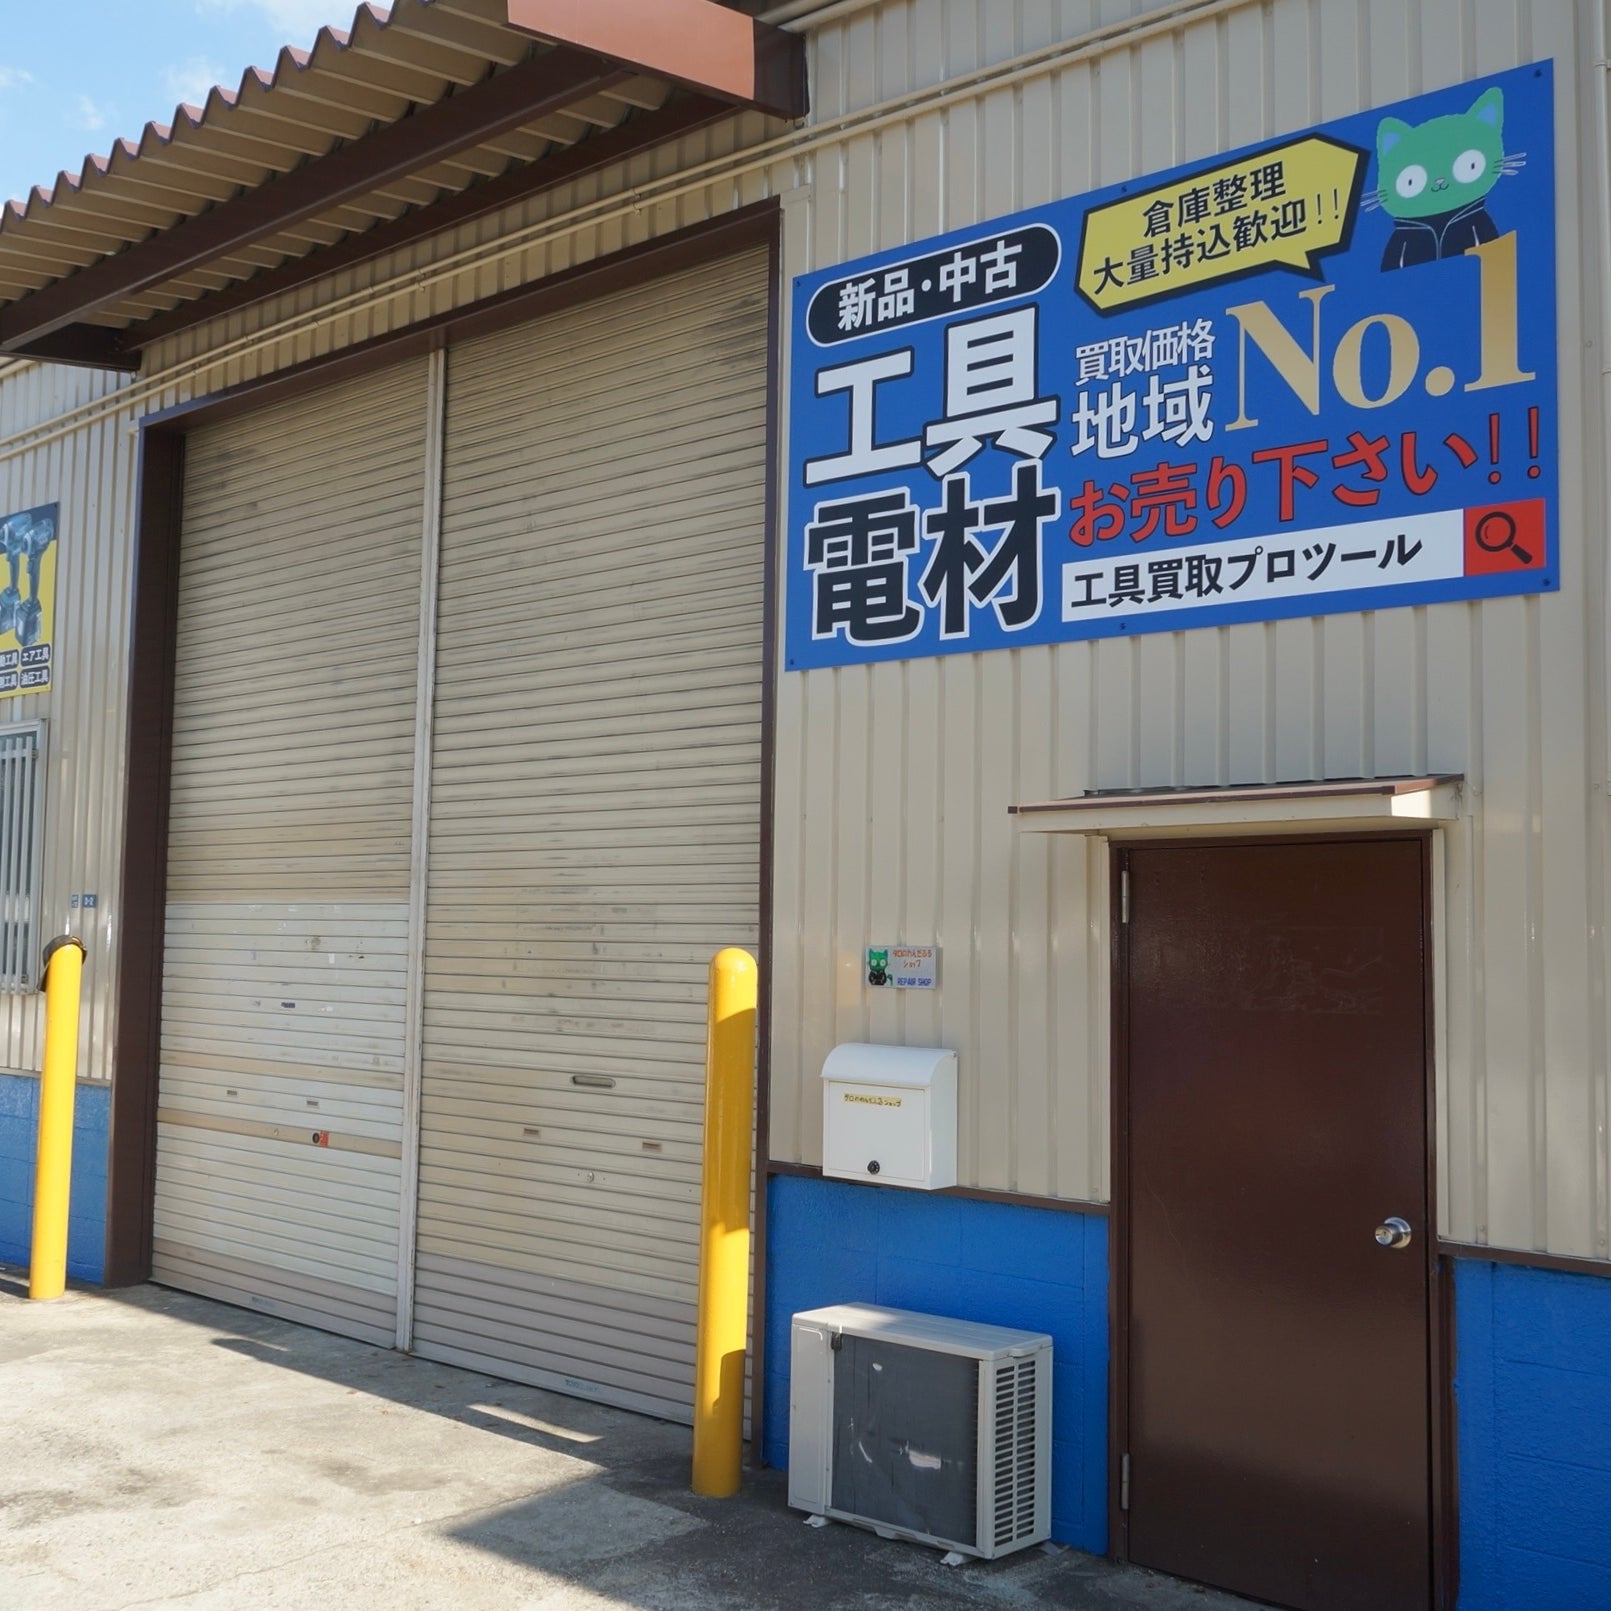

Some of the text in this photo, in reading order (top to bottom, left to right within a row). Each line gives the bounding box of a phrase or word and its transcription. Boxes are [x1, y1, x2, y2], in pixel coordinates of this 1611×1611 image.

[1142, 160, 1287, 238] 倉庫整理
[837, 239, 1023, 332] 新品・中古
[1070, 230, 1537, 459] 地域 No.1
[1075, 318, 1216, 386] 買取価格
[804, 304, 1059, 487] 工具
[803, 458, 1061, 646] 電材
[1070, 534, 1423, 608] 工具買取プロツール
[21, 669, 49, 686] 油圧工具
[22, 646, 49, 662] エア工具
